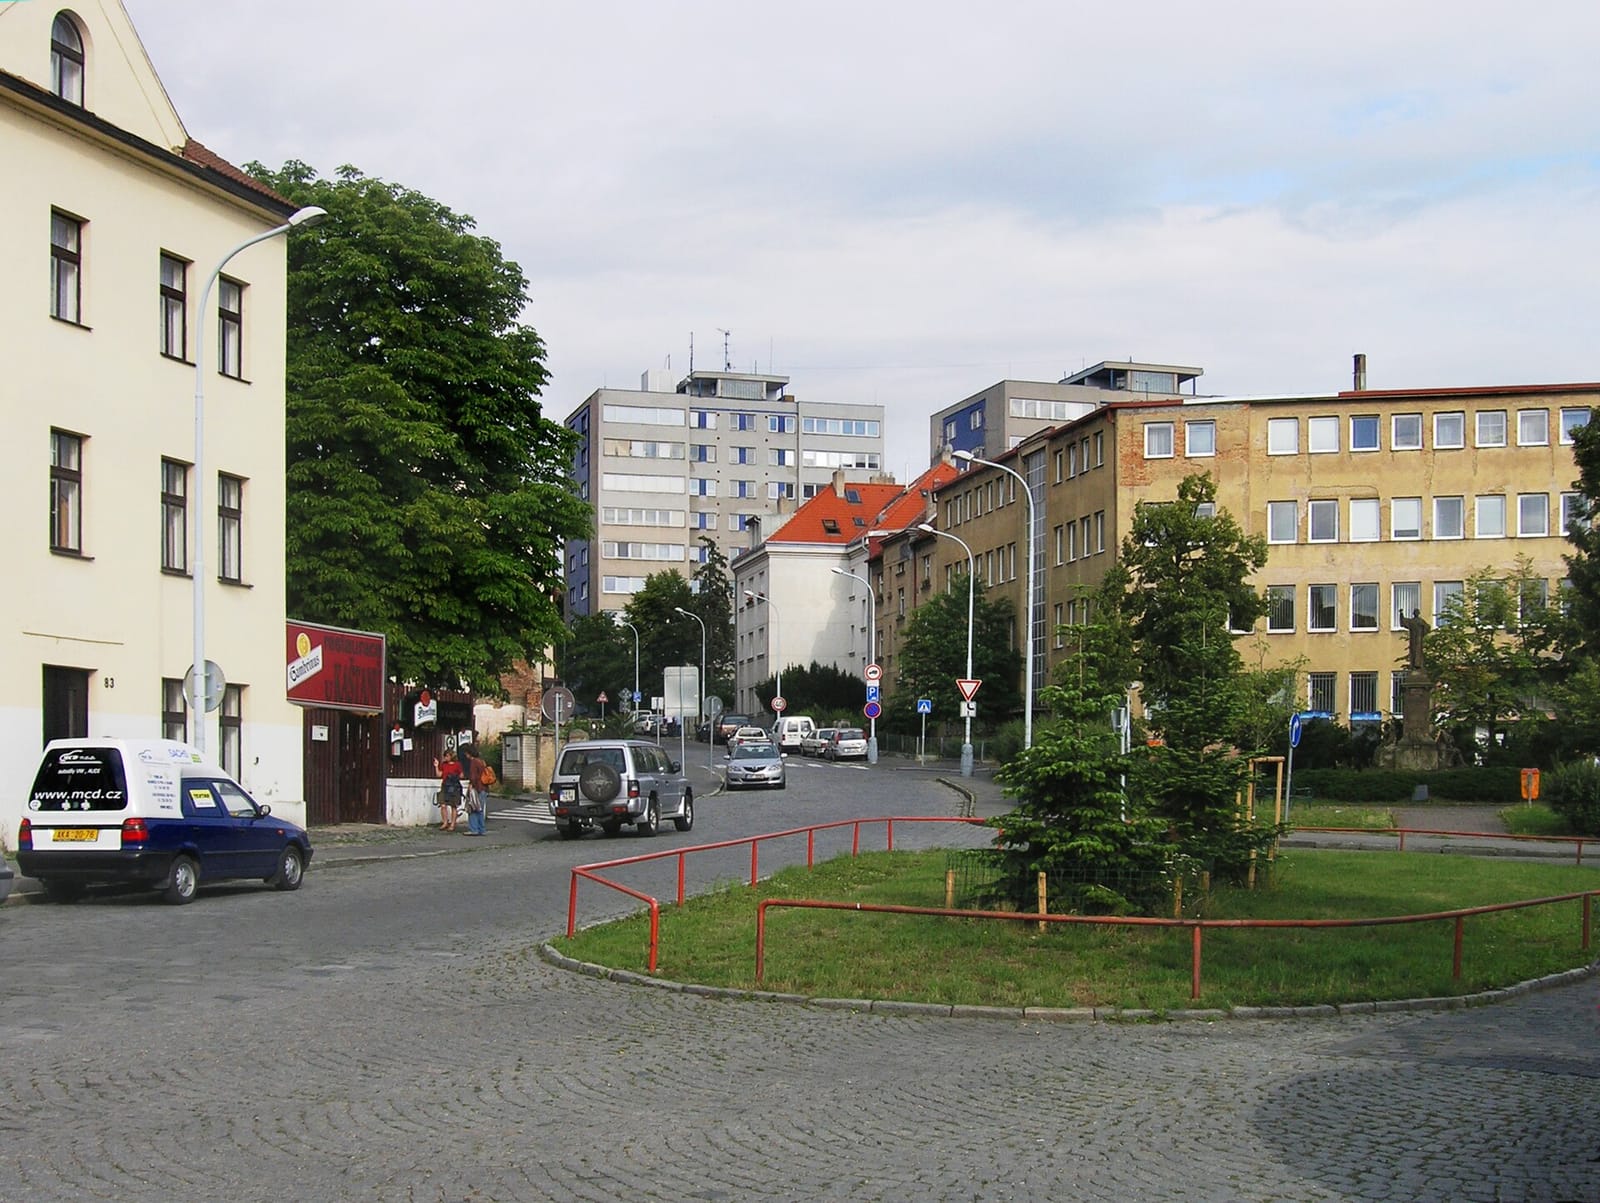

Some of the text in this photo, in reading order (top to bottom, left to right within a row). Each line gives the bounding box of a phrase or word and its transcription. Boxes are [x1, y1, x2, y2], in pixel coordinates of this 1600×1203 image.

[289, 655, 320, 682] Gambrinus
[104, 677, 114, 688] 83
[869, 687, 876, 696] P
[34, 789, 122, 800] www.mcd.cz
